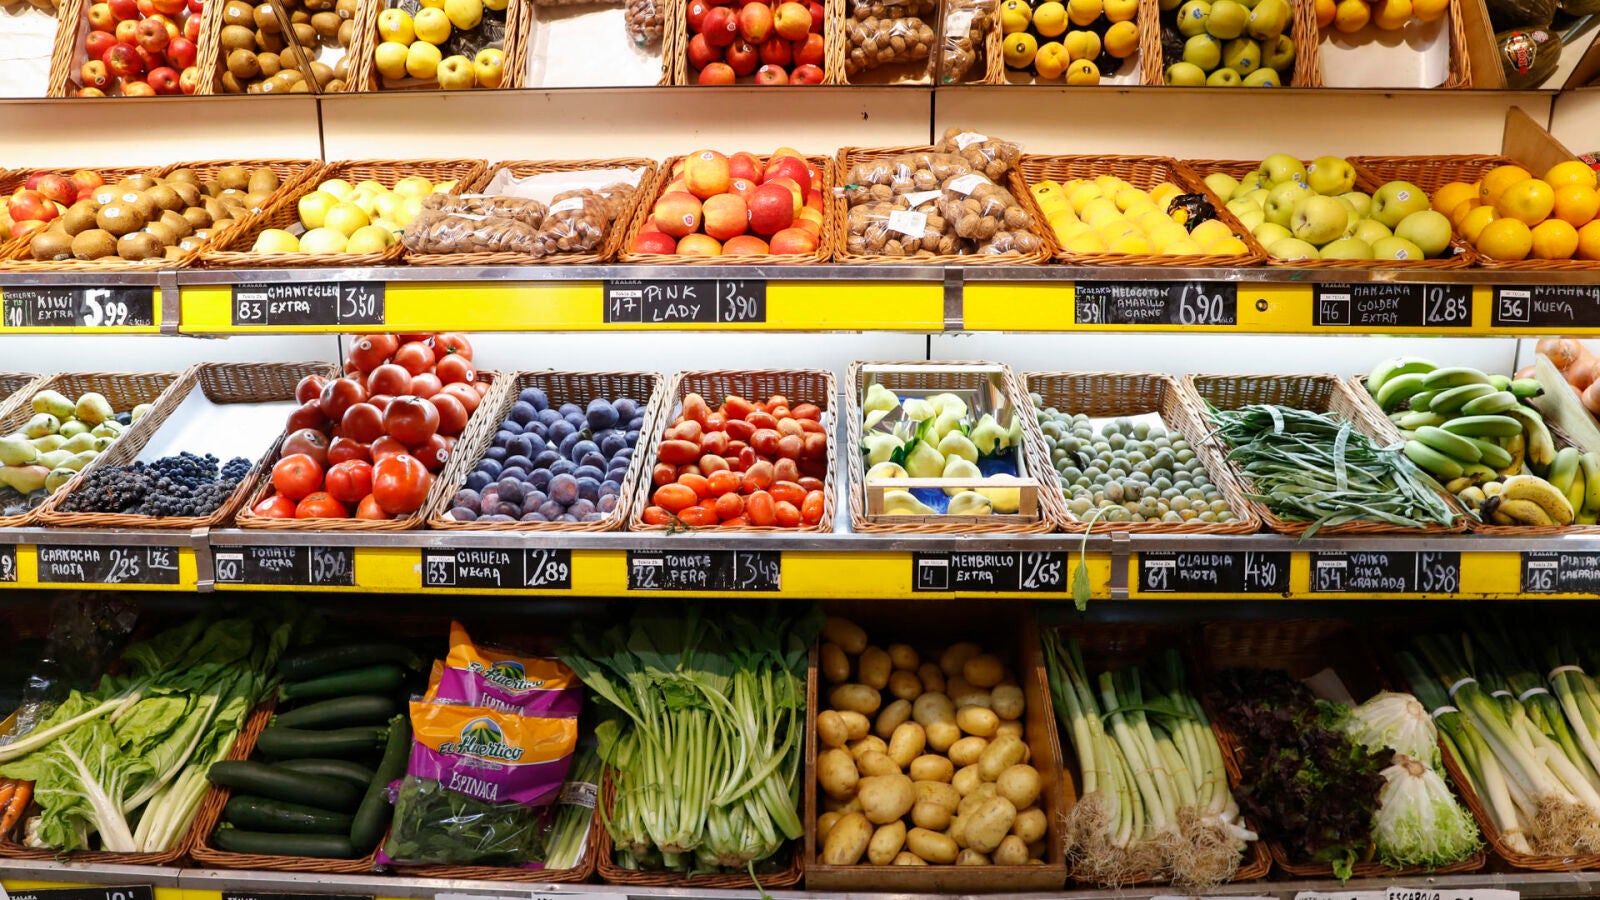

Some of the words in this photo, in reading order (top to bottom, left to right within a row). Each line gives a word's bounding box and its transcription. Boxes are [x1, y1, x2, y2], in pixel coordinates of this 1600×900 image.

[239, 302, 262, 319] 83
[270, 301, 310, 314] EXTRA
[612, 298, 637, 316] 17
[1117, 298, 1165, 308] AMARILLO
[1322, 301, 1340, 321] 46
[1501, 299, 1523, 317] 36
[9, 306, 23, 327] 10
[38, 309, 74, 321] EXTRA
[653, 303, 701, 322] LADY
[1081, 302, 1099, 323] 39
[1360, 312, 1398, 325] EXTRA
[152, 551, 170, 566] 76
[251, 547, 296, 558] TOMATE
[665, 555, 711, 568] TOMATE
[951, 554, 1014, 568] MEMBRILLO
[218, 560, 237, 580] 60
[259, 558, 293, 568] EXTRA
[429, 561, 448, 583] 55
[632, 566, 659, 588] 72
[670, 570, 707, 586] PERA
[923, 567, 934, 584] 4
[956, 570, 994, 584] EXTRA
[1147, 567, 1168, 590] 61
[1320, 567, 1342, 590] 54
[1529, 569, 1553, 589] 16
[456, 736, 525, 761] Huertico
[448, 771, 499, 801] ESPINACA
